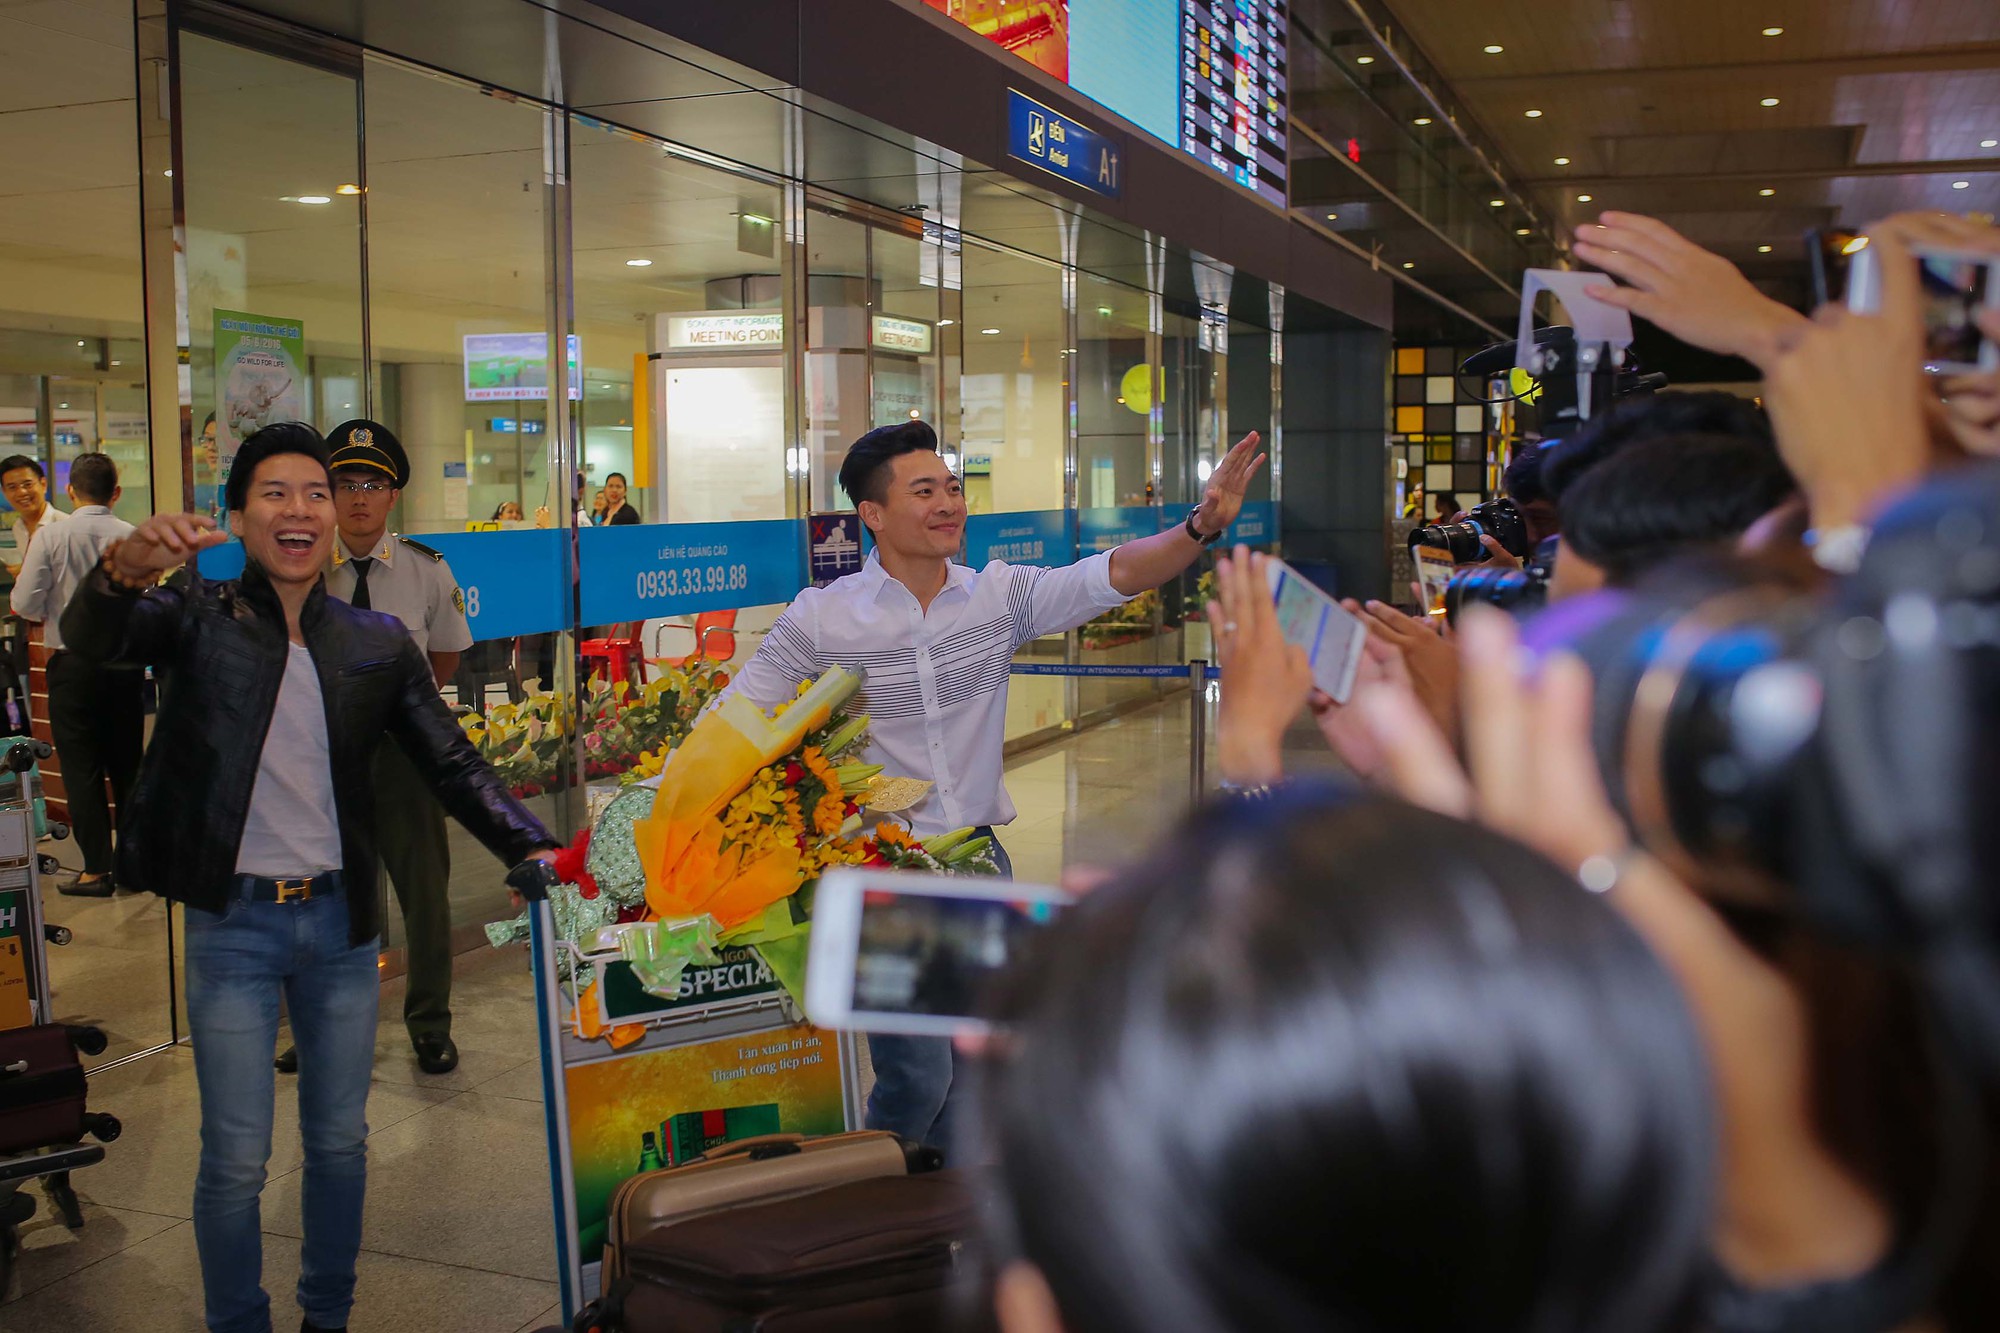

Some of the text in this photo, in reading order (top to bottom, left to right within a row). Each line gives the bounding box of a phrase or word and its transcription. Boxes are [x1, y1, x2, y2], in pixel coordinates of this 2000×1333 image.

[690, 330, 746, 343] MEETING
[246, 357, 261, 366] WILD
[261, 359, 273, 367] FOR
[273, 360, 285, 368] LIFE
[658, 546, 675, 560] LIÊN
[637, 564, 748, 599] 0933.33.99.88
[680, 963, 779, 998] SPECIA
